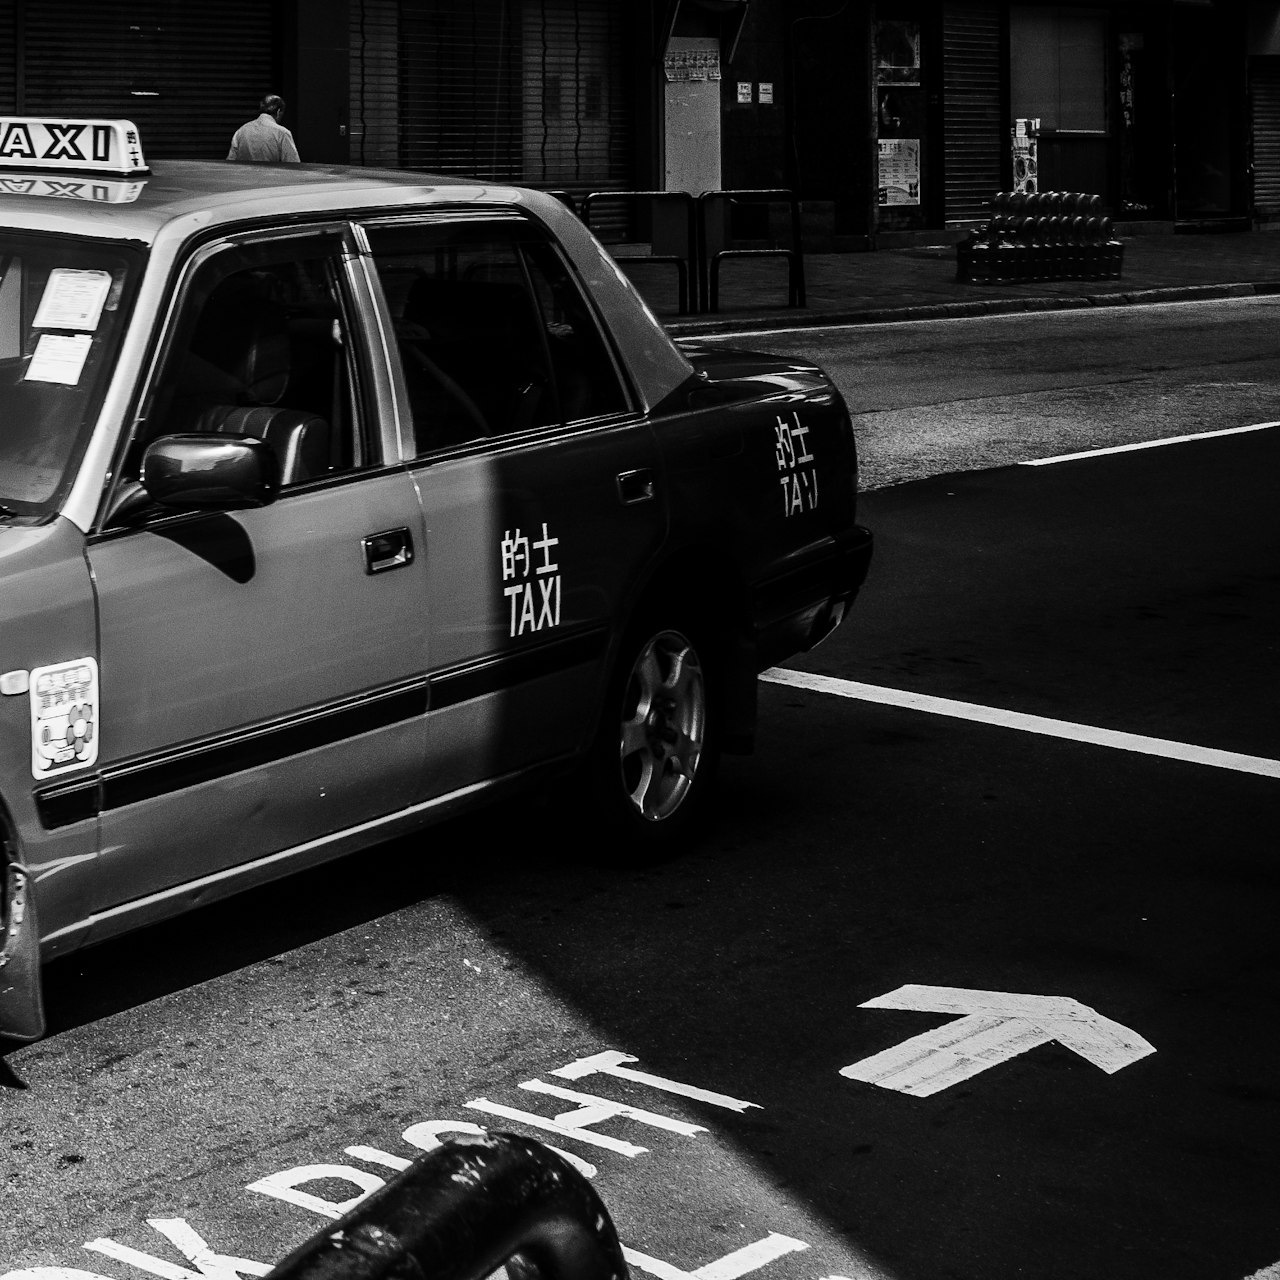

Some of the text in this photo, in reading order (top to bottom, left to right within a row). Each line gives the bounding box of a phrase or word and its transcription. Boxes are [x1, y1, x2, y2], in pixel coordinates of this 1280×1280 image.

[773, 411, 815, 470] 的士
[501, 522, 559, 581] 的士
[503, 575, 561, 638] TAXI
